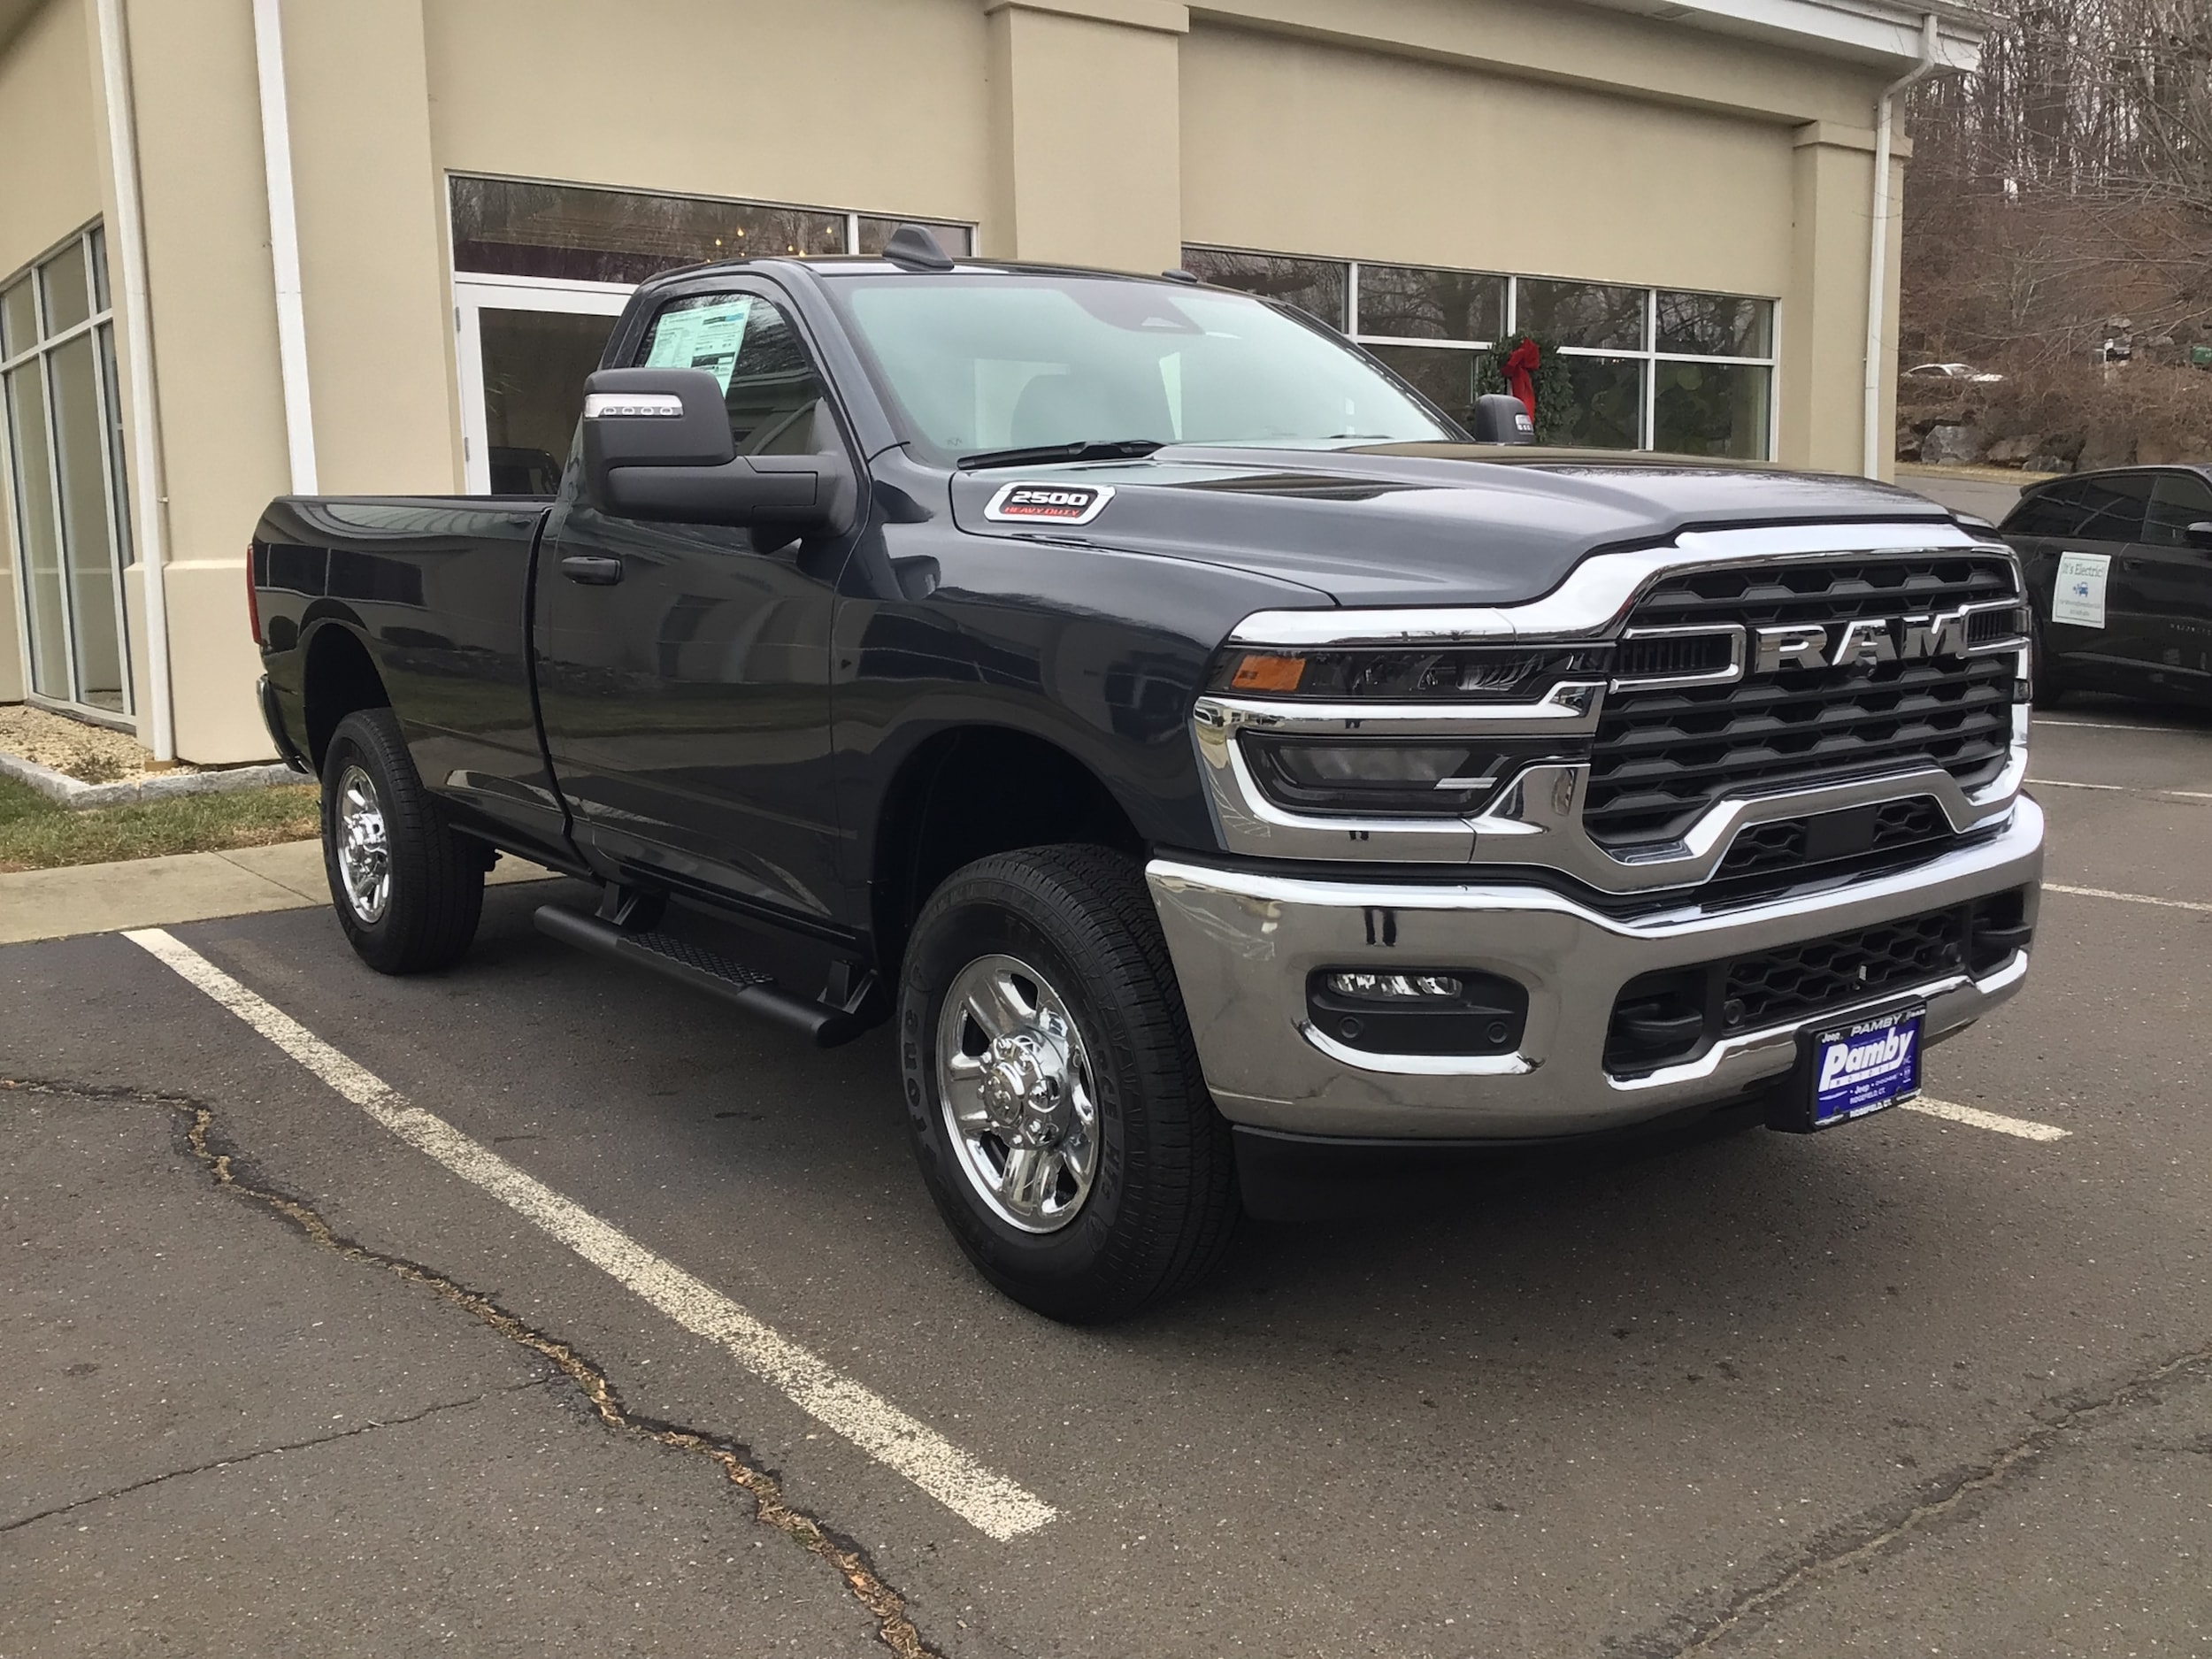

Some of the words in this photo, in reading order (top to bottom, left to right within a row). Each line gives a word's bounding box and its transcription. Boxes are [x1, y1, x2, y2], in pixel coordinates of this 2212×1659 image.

[1010, 490, 1089, 507] 2500
[1004, 506, 1045, 516] HEAVY
[1044, 508, 1080, 518] DUTY
[1755, 612, 1964, 674] RAM
[1850, 1013, 1902, 1037] PAMBY
[1821, 1032, 1842, 1044] Jeep
[1818, 1026, 1915, 1093] Pamby
